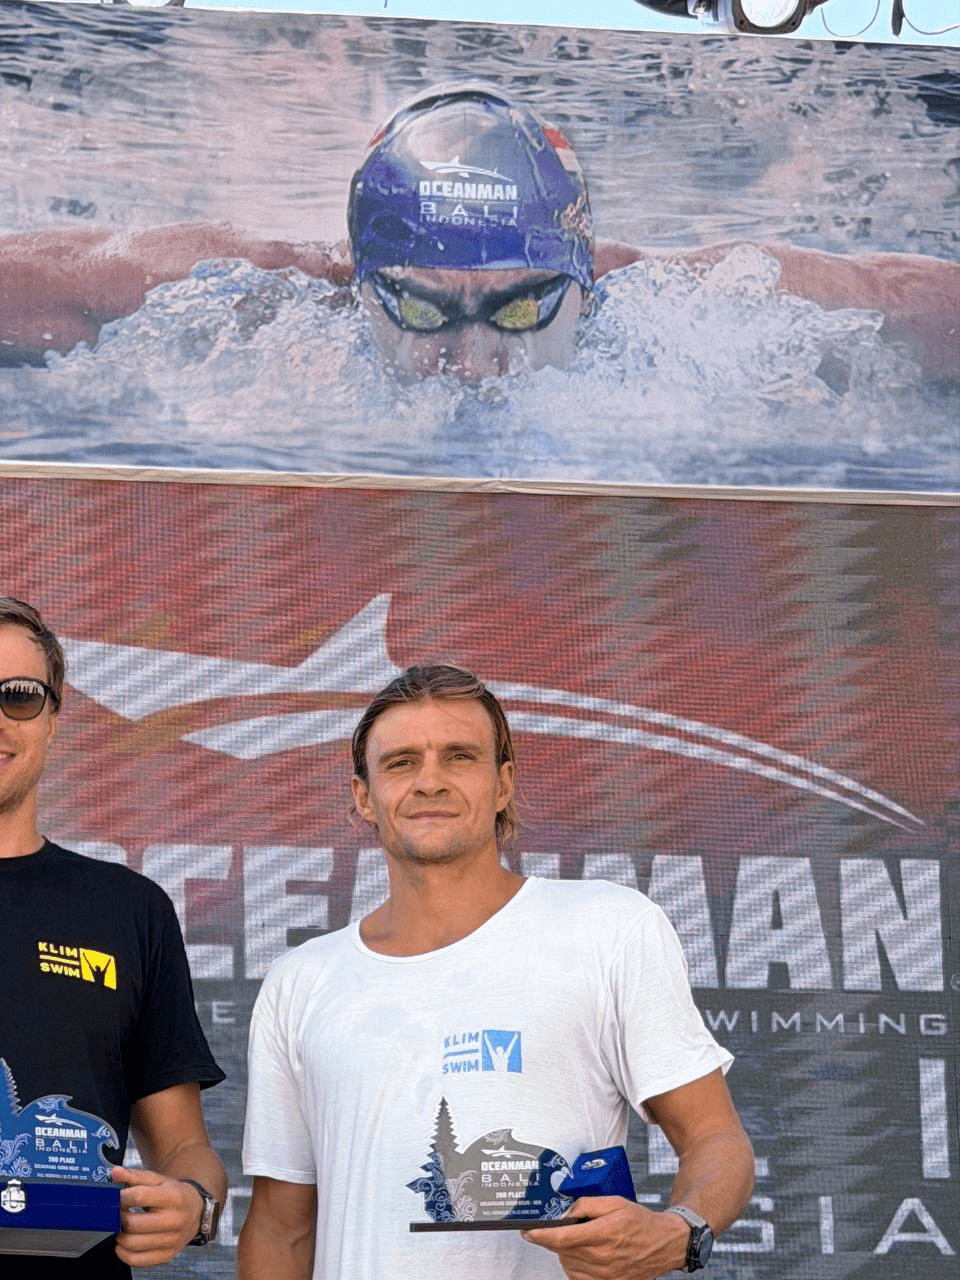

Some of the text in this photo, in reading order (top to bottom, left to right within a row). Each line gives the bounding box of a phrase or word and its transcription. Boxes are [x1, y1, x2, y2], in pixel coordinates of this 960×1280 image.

[419, 181, 518, 200] OCEANMAN
[419, 201, 518, 218] BALI
[419, 215, 518, 227] INDONESIA
[80, 842, 944, 992] CEMAN
[38, 941, 78, 958] KLIM
[39, 962, 81, 979] SWIM
[704, 1008, 949, 1036] WIMMING
[443, 1031, 480, 1049] KLIM
[442, 1059, 480, 1075] SWIM
[35, 1126, 88, 1139] OCEANMAN
[35, 1138, 88, 1150] BALI
[480, 1160, 540, 1171] OCEANMAN
[481, 1172, 540, 1183] BALI
